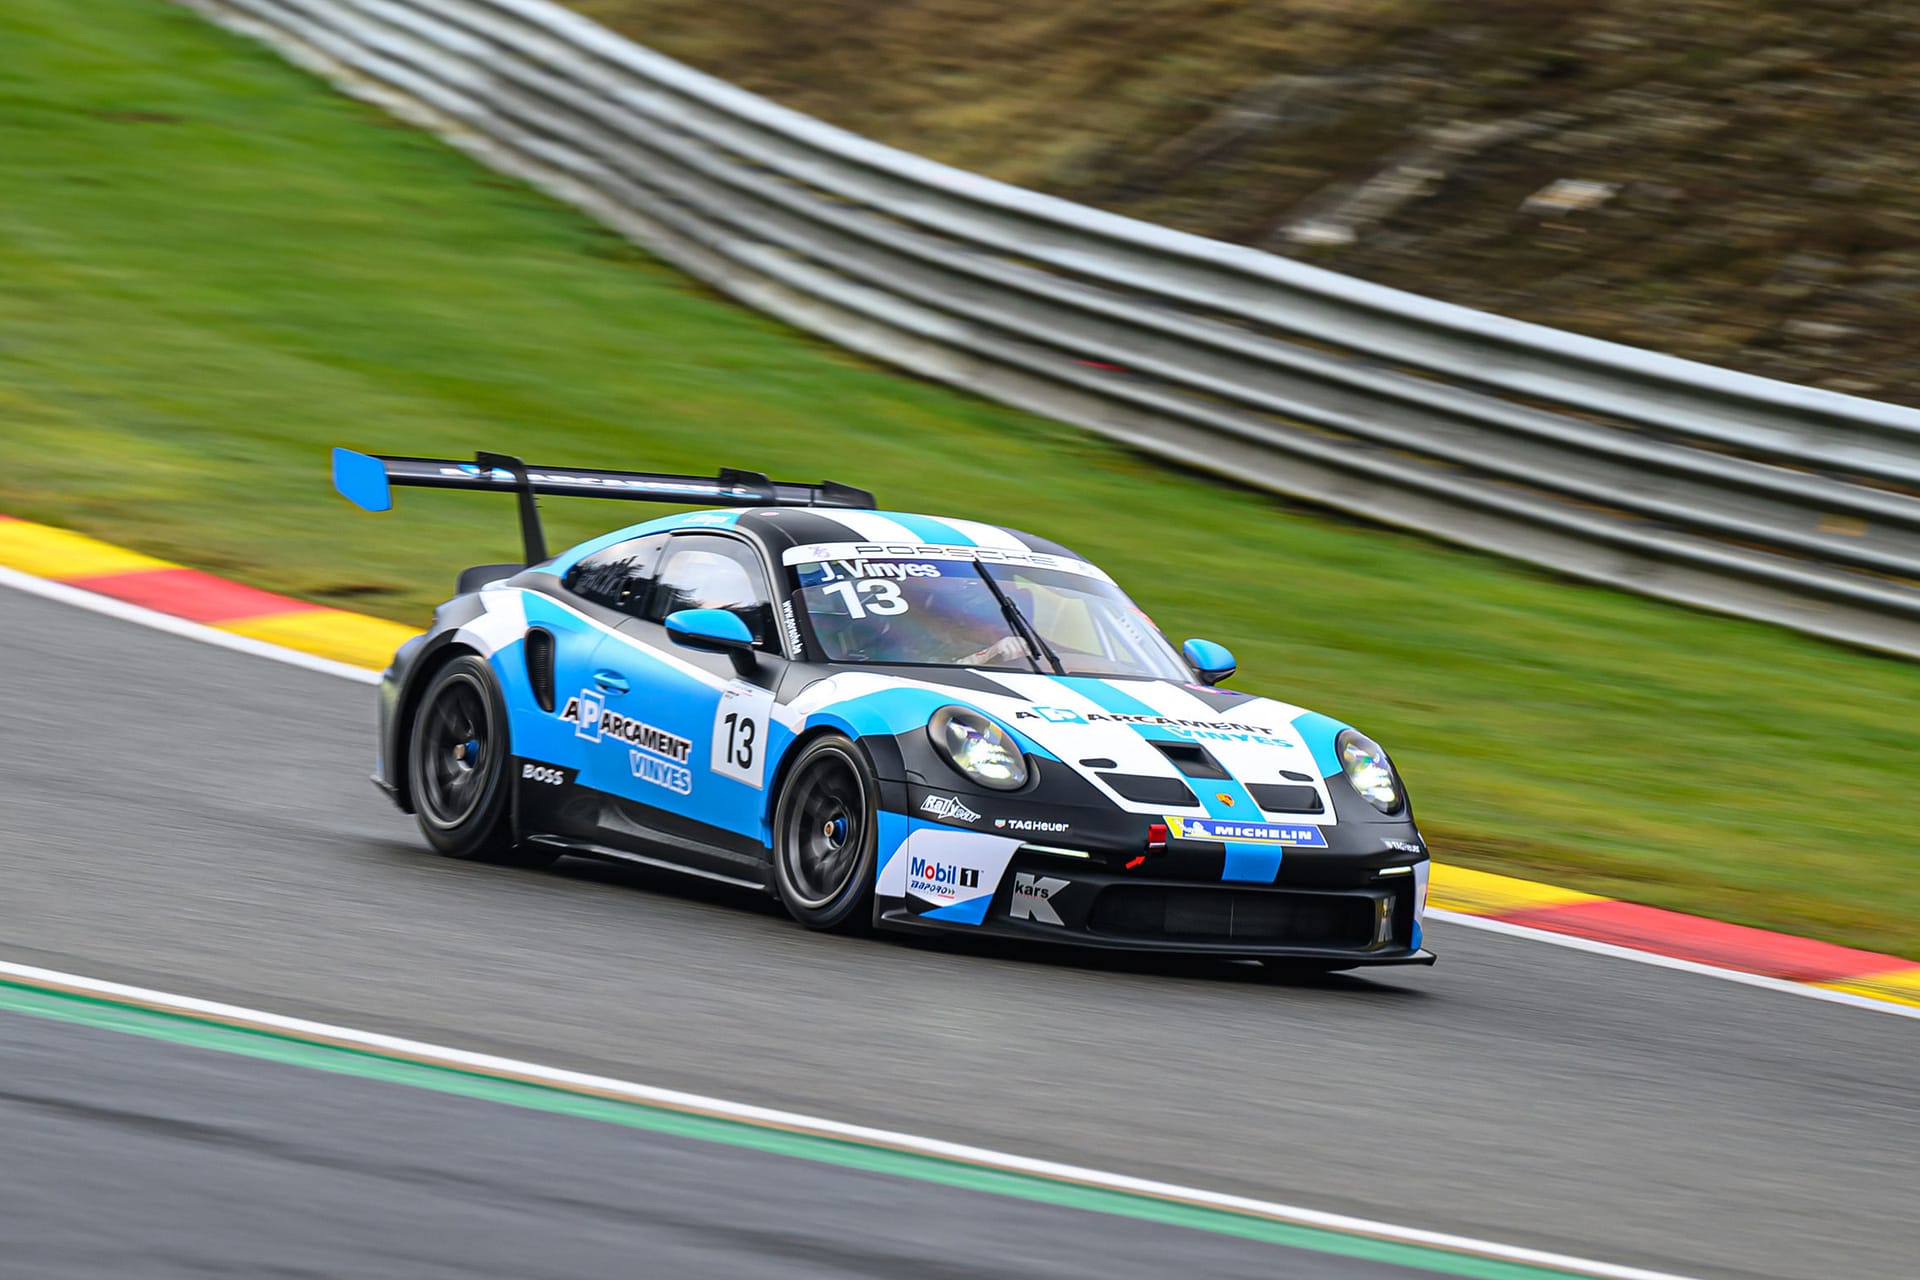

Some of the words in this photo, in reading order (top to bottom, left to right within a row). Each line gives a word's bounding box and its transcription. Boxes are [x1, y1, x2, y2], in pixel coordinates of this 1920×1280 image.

[855, 546, 1058, 567] PORSCHE
[821, 579, 909, 619] 13
[724, 713, 755, 769] 13
[1168, 727, 1294, 748] VINYES
[522, 763, 564, 786] BOSS
[629, 750, 692, 795] VINYES
[1215, 825, 1312, 841] MICHELIN
[911, 856, 957, 885] Mobil
[1015, 880, 1049, 899] kars
